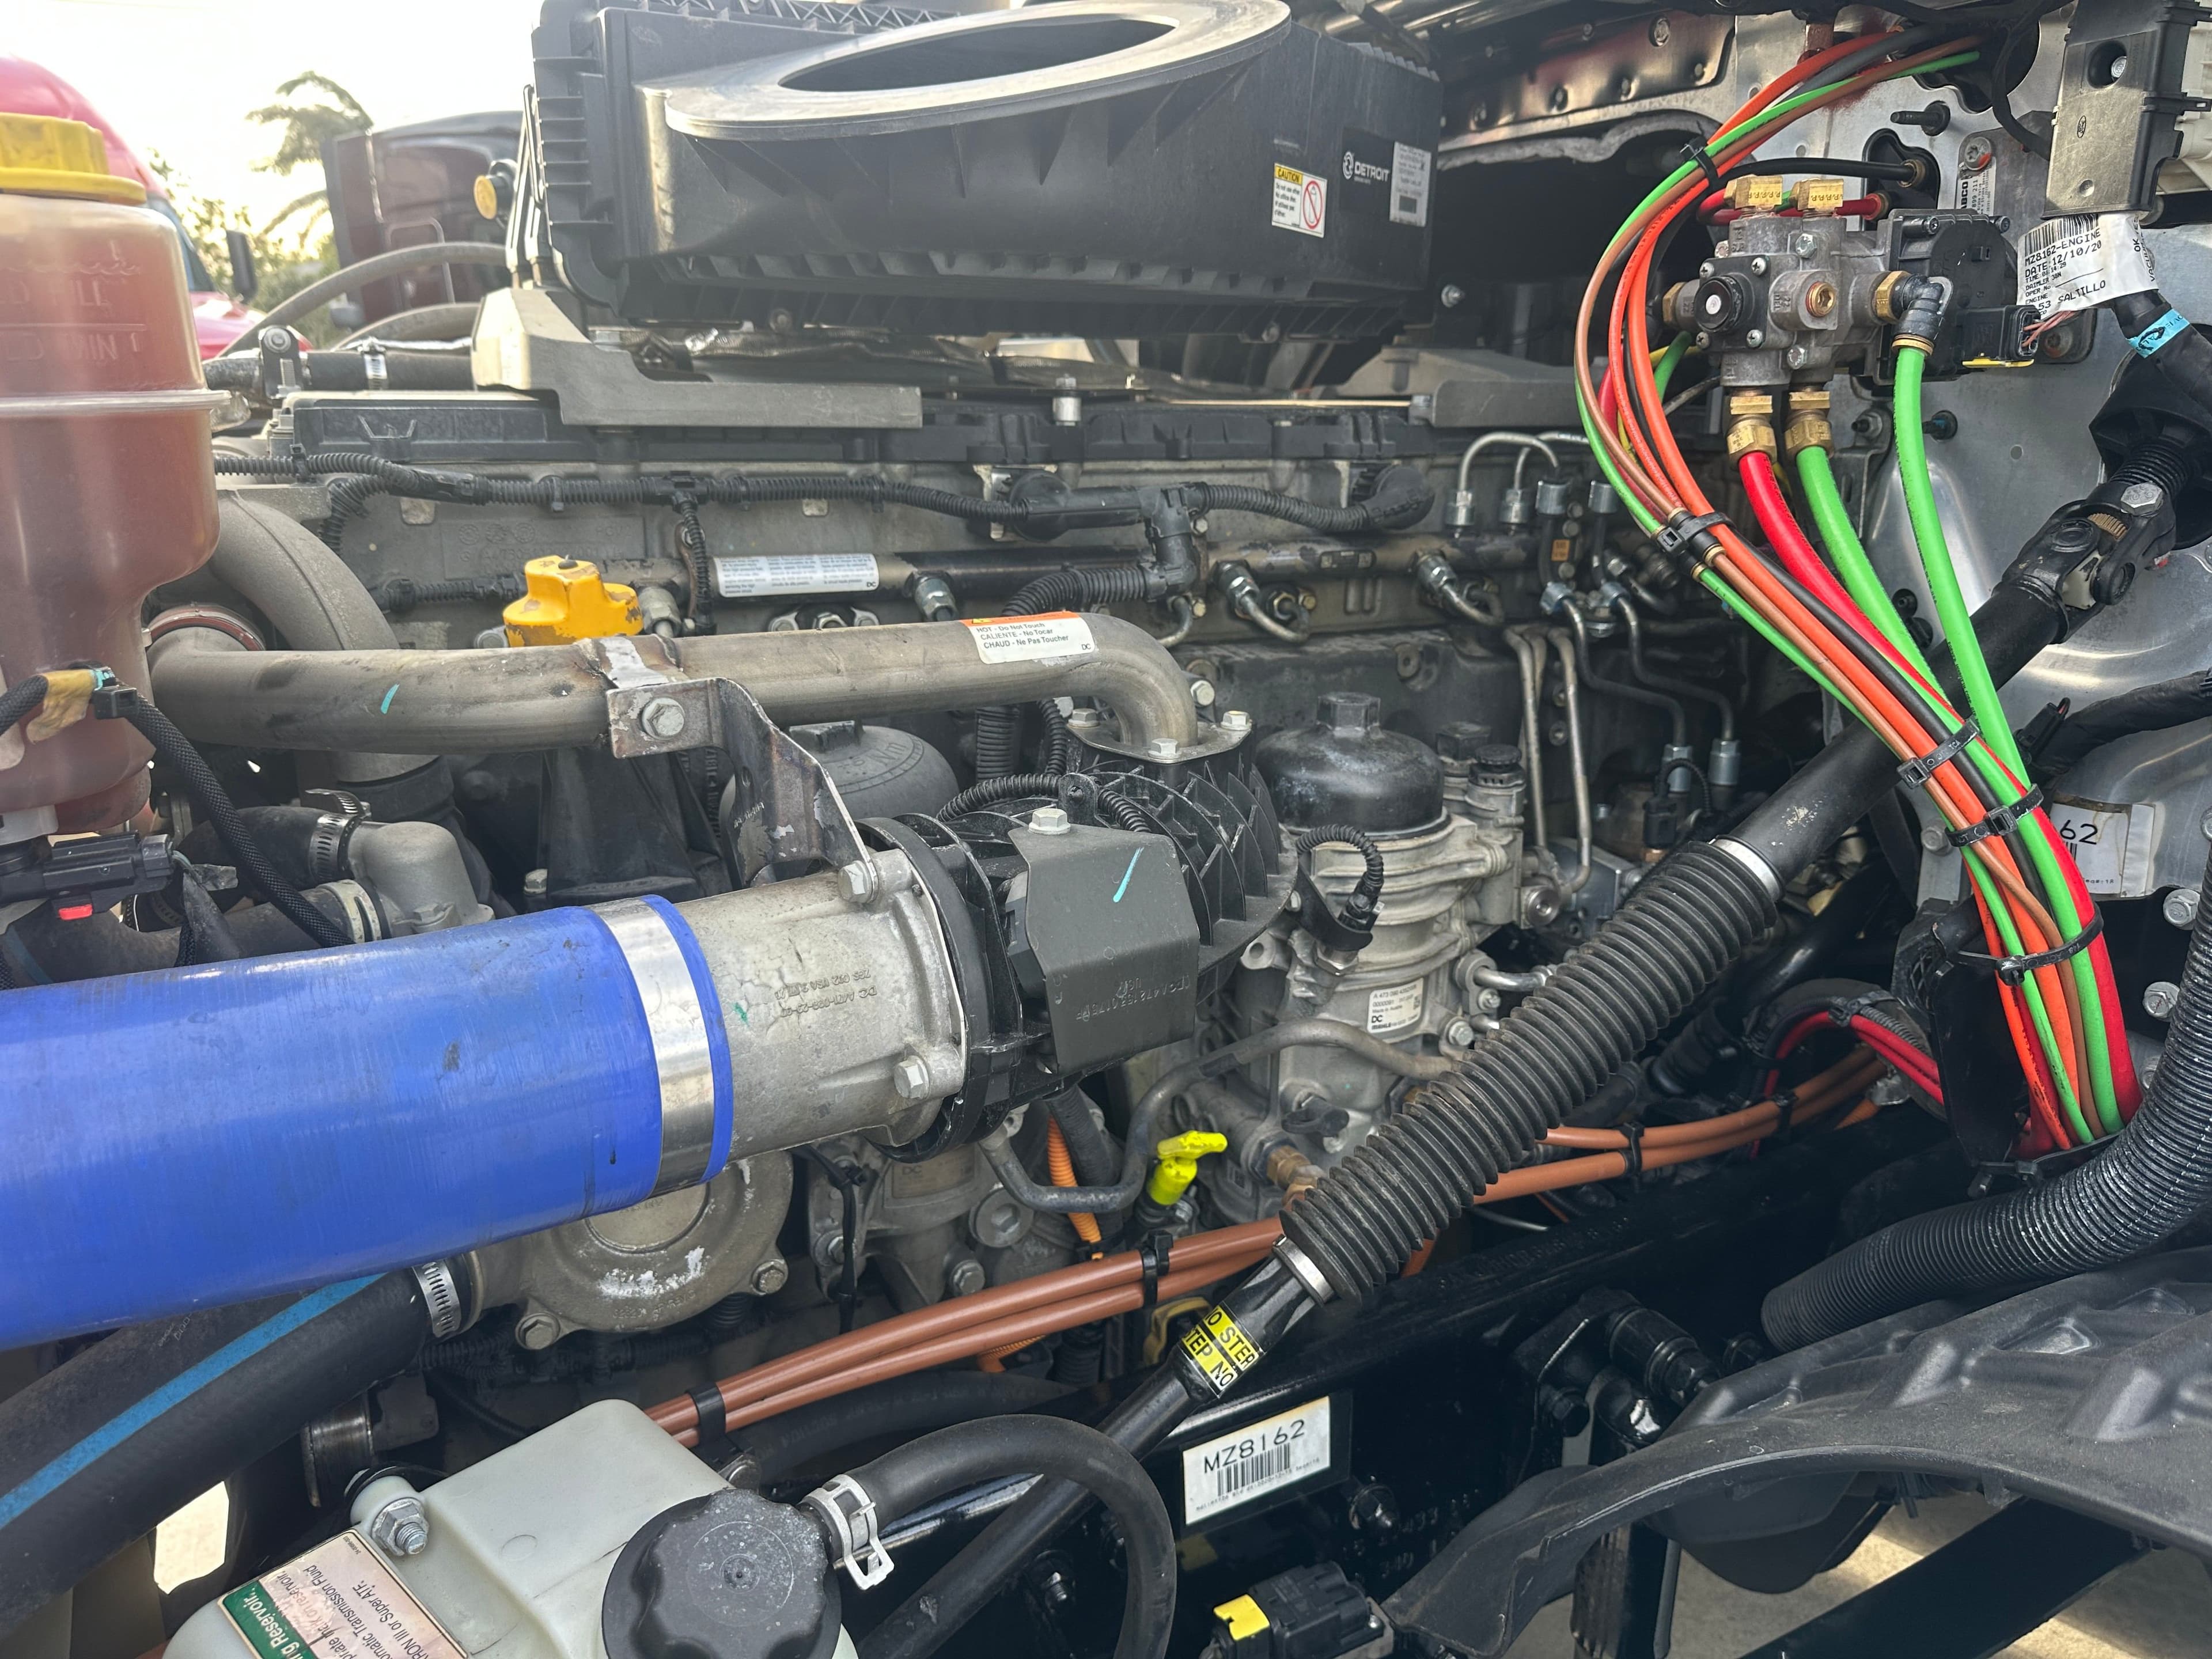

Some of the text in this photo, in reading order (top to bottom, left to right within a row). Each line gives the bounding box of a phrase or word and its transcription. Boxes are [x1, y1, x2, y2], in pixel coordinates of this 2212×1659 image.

[1278, 167, 1300, 183] CAUTION
[1354, 161, 1389, 182] DETROIT
[2025, 228, 2101, 267] MZ8162-ENGINE
[2133, 238, 2142, 252] OK
[2025, 286, 2041, 298] OPER
[2025, 293, 2049, 305] ENGINE
[2058, 279, 2107, 304] SALTILLO
[980, 632, 1018, 641] CALIENTE
[983, 640, 1011, 649] CHAUD
[1041, 635, 1069, 643] Toucher
[1371, 1014, 1383, 1024] DC
[1210, 1361, 1234, 1388] NO
[1204, 1419, 1305, 1474] MZ8162
[305, 1564, 327, 1587] Fluid
[321, 1581, 366, 1638] Transmission
[369, 1593, 395, 1624] Super
[387, 1619, 402, 1632] or
